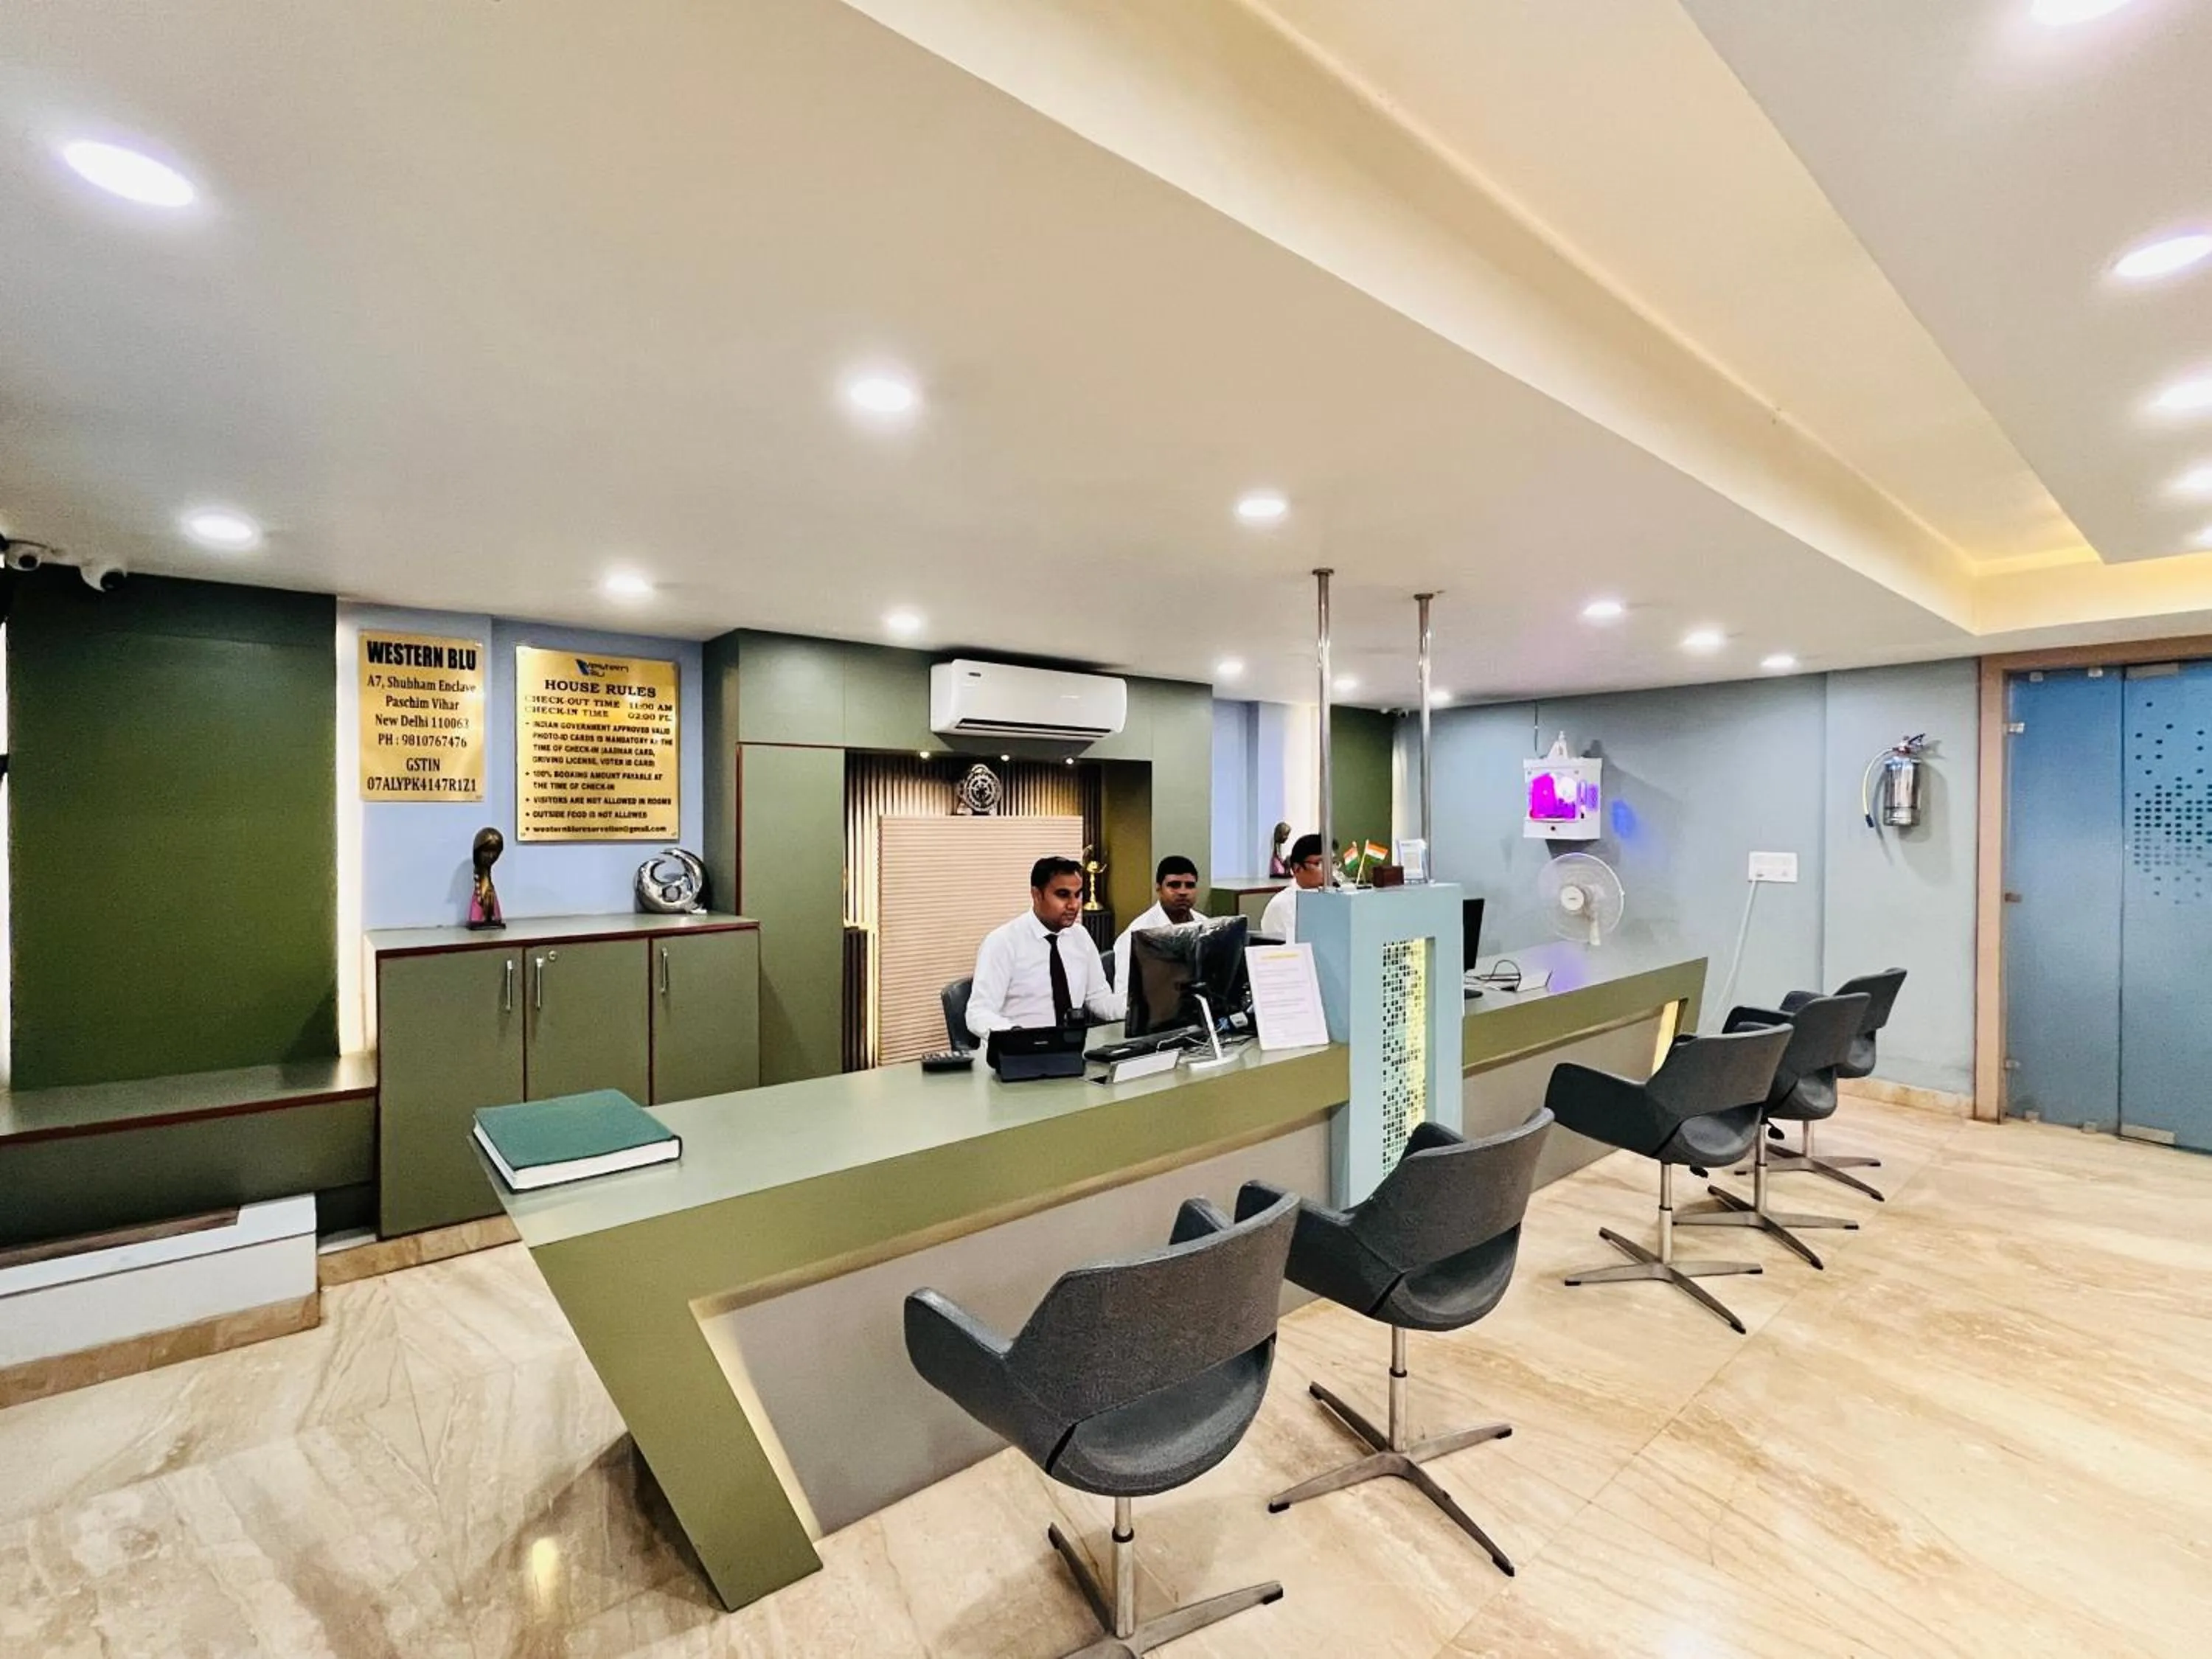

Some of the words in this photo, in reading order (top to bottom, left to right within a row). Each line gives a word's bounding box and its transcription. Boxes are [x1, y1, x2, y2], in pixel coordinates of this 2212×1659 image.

[367, 640, 443, 668] WESTERN
[448, 647, 476, 671] BLU
[367, 675, 384, 689] A7,
[387, 676, 436, 691] Shubham
[439, 679, 476, 693] Enclave
[545, 679, 600, 694] HOUSE
[606, 684, 656, 698] RULES
[386, 695, 429, 709] Paschim
[431, 698, 459, 710] Vihar
[593, 699, 620, 708] TIME
[581, 709, 608, 717] TIME
[375, 714, 399, 726] New
[400, 714, 428, 728] Delhi
[560, 723, 611, 731] GOVERNMENT
[378, 733, 393, 745] PH
[402, 734, 467, 748] 9810767476
[570, 734, 594, 742] CARDS
[605, 736, 648, 744] MANDATORY
[406, 757, 440, 771] GSTIN
[604, 797, 636, 805] ALLOWED
